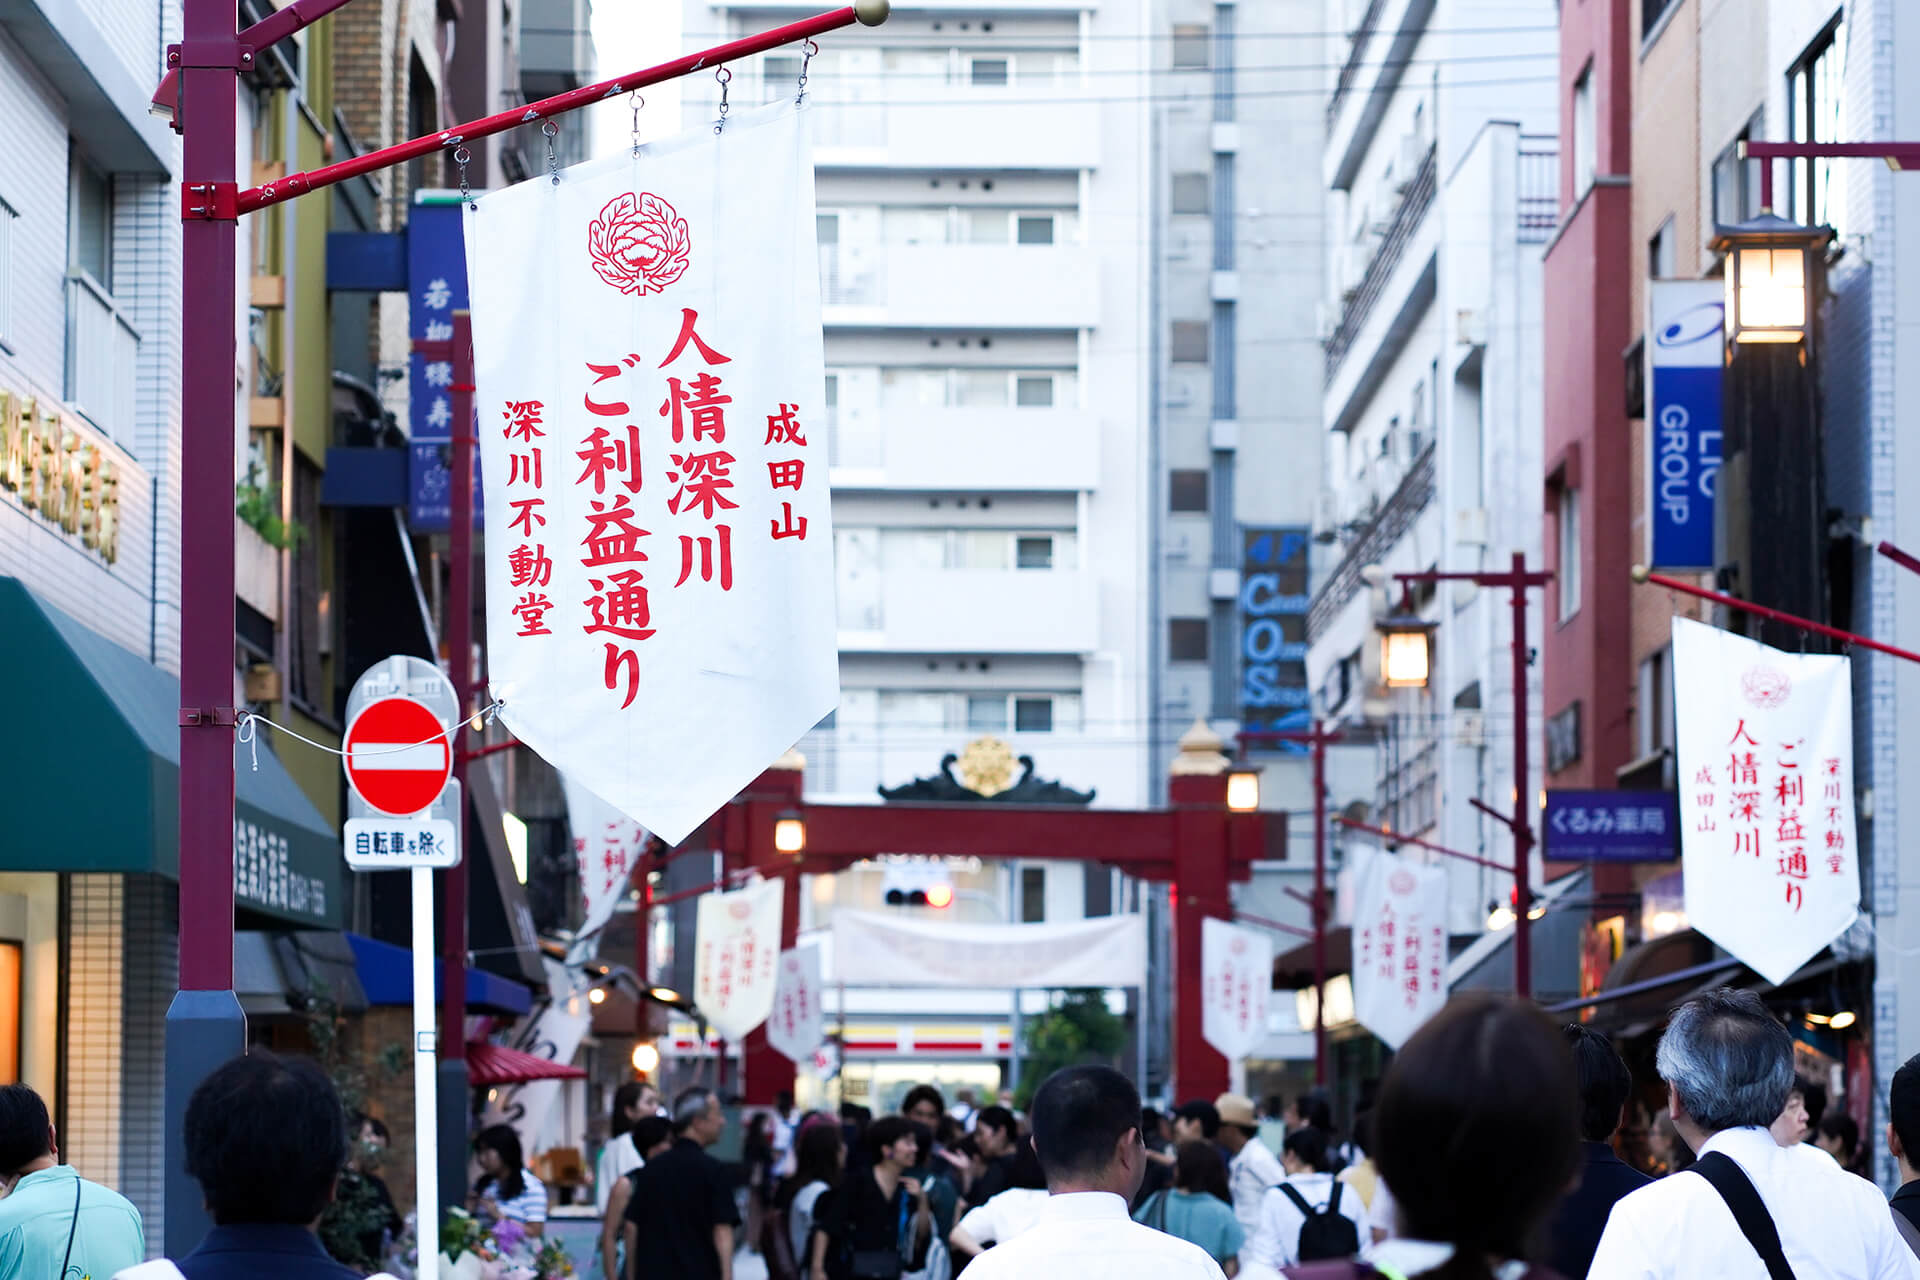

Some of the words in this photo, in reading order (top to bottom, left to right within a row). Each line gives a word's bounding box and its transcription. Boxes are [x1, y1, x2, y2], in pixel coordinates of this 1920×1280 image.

[502, 400, 554, 637] 深川不動堂
[658, 308, 740, 592] 人情深川
[764, 403, 808, 541] 成田山
[1660, 404, 1689, 524] GROUP
[576, 353, 656, 709] ご利益通り
[356, 831, 445, 857] 自転車を除く
[1552, 807, 1666, 834] くるみ薬局
[1696, 766, 1715, 833] 成田山
[1727, 718, 1761, 857] 人情深川
[1774, 737, 1809, 913] ご利益通り
[1822, 758, 1845, 875] 深川不動堂
